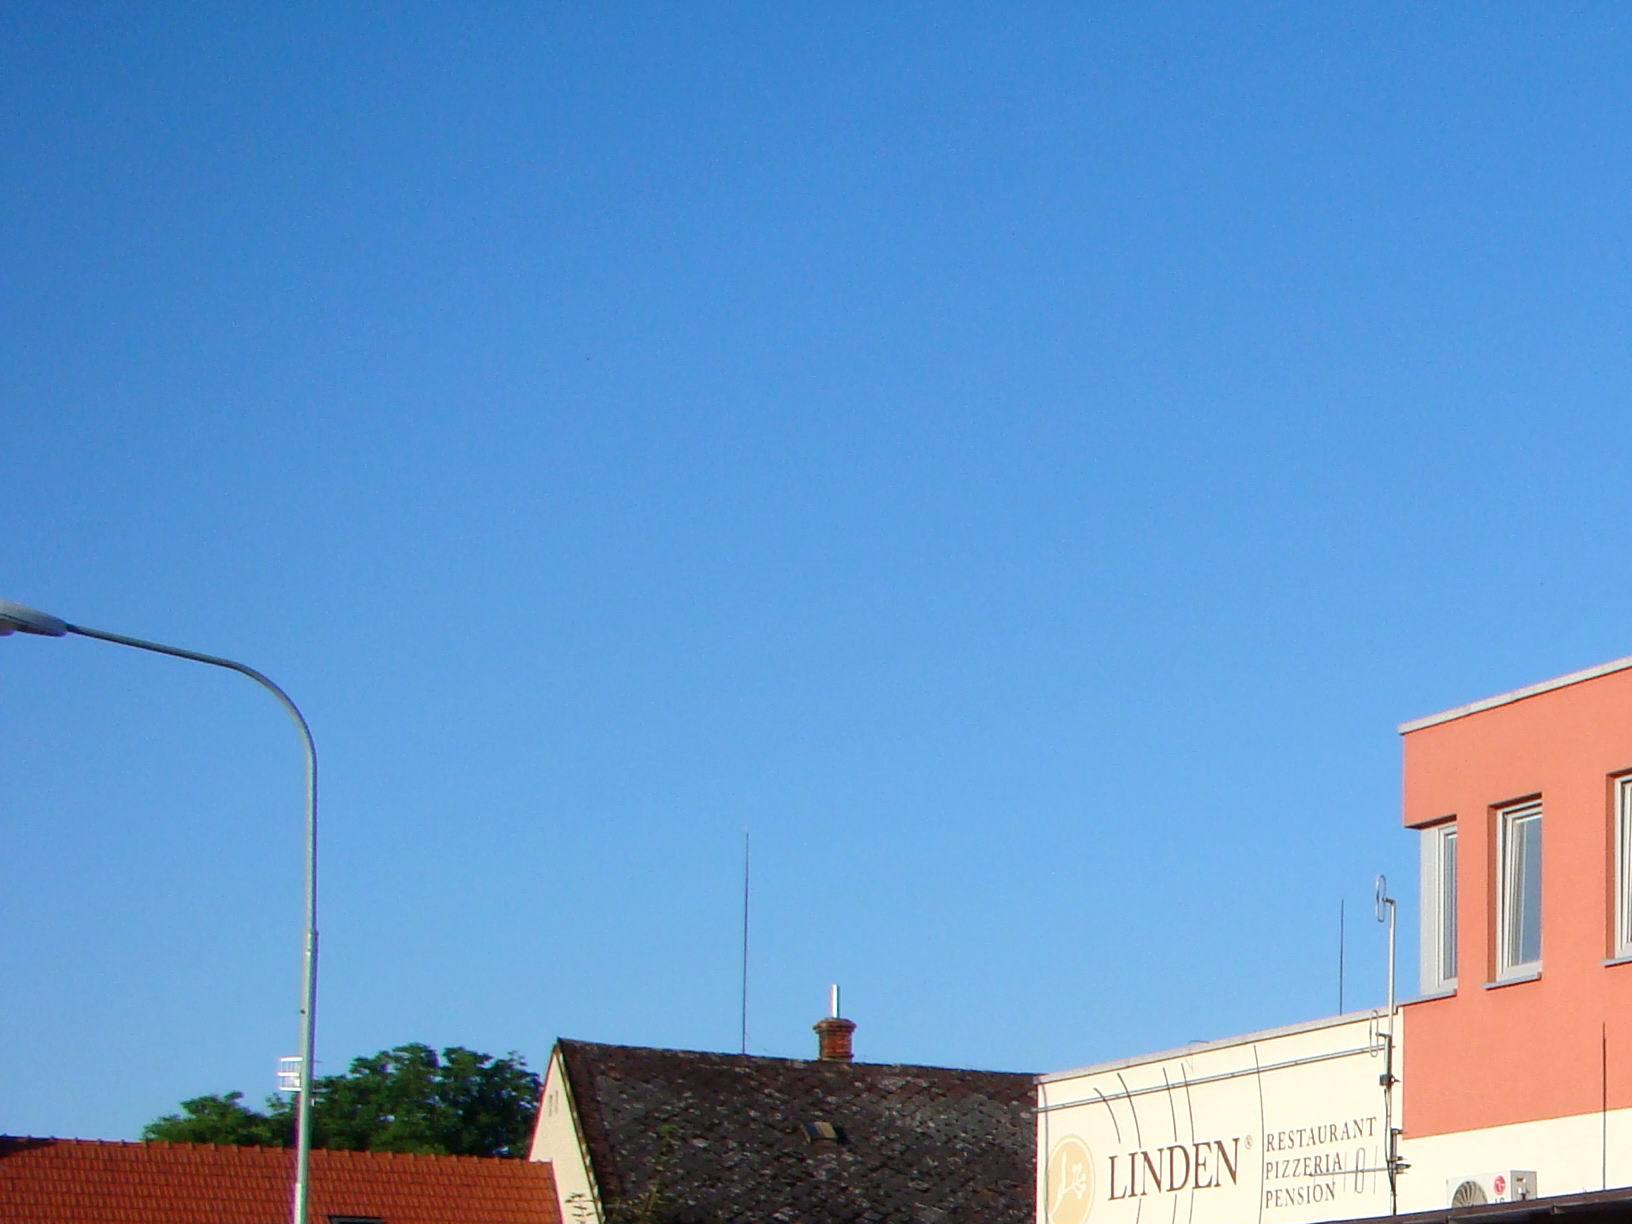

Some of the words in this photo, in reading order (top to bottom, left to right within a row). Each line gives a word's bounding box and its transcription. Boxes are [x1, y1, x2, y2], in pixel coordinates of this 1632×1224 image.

[1266, 1116, 1377, 1152] RESTAURANT
[1265, 1152, 1343, 1180] PIZZERIA
[1265, 1181, 1336, 1209] PENSION
